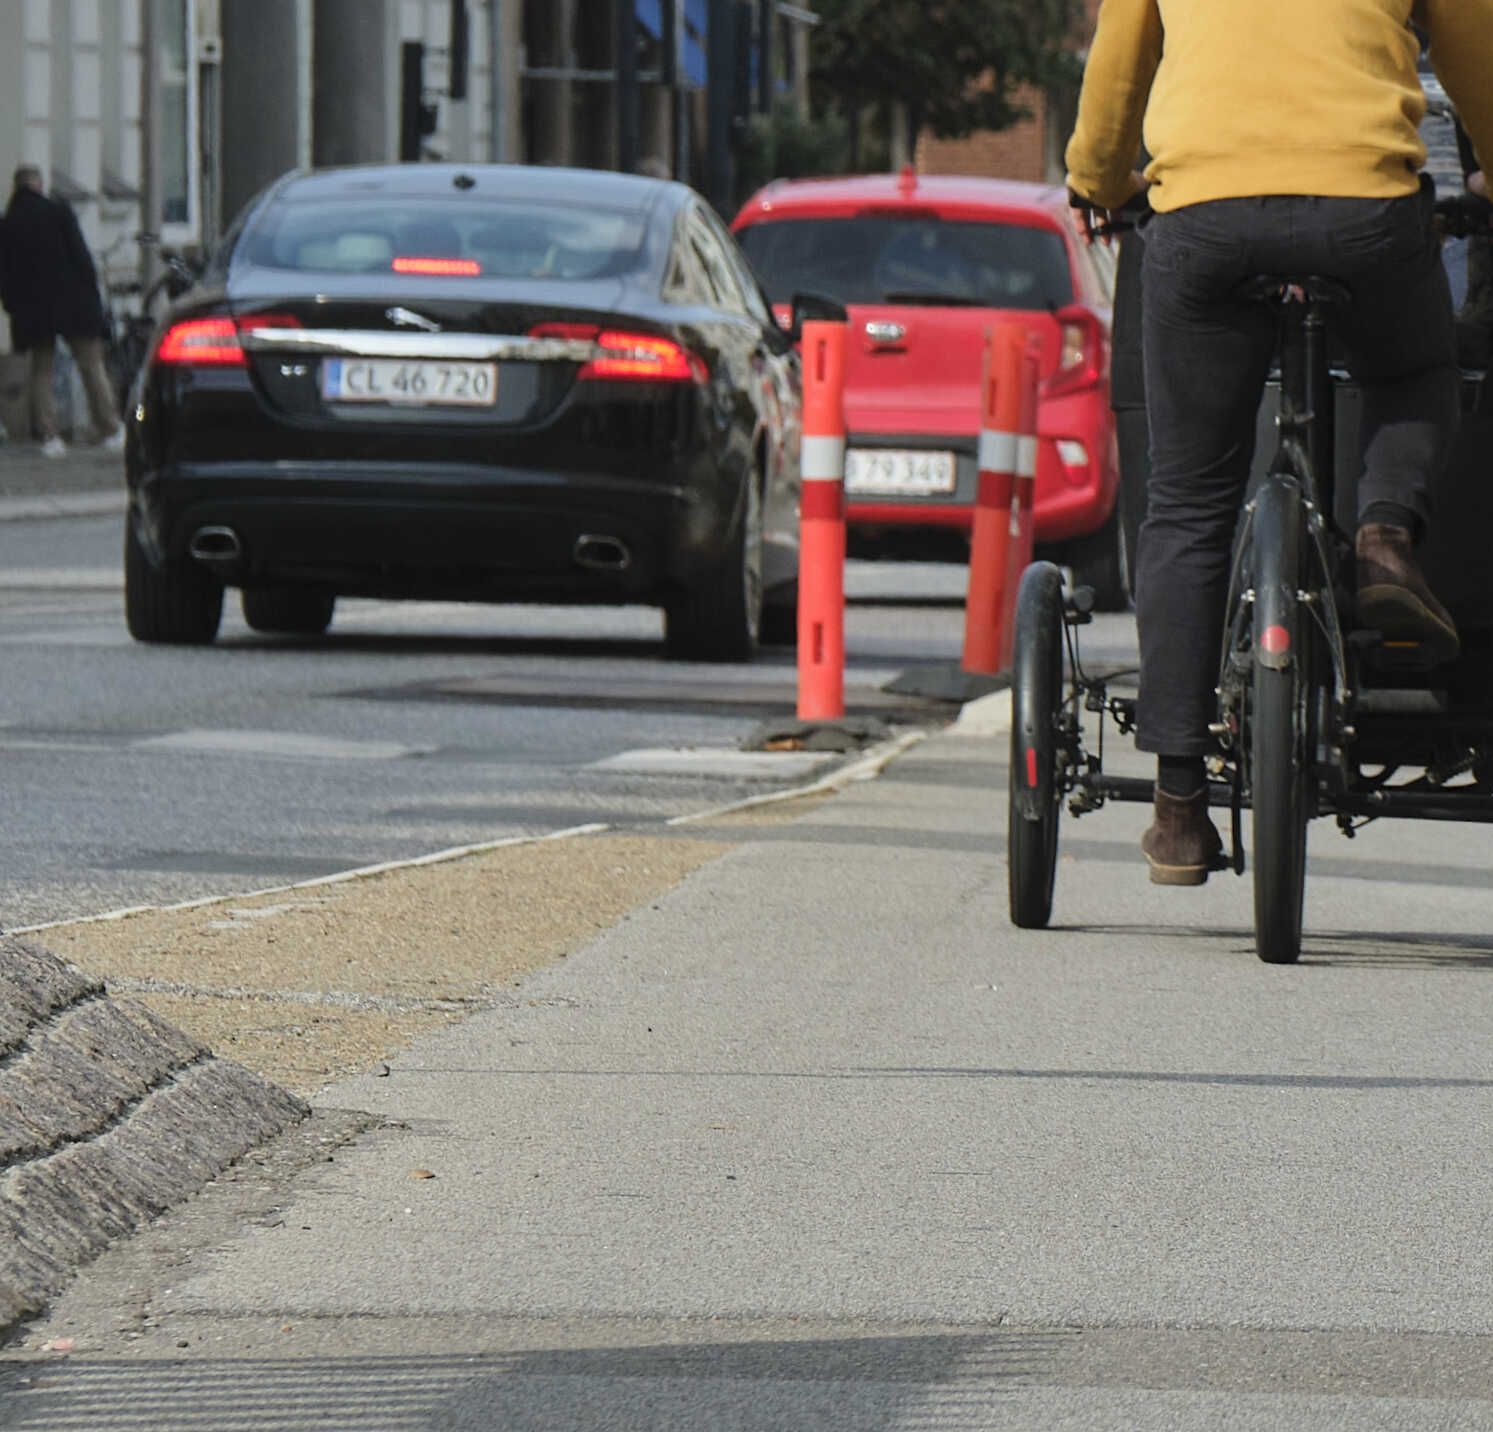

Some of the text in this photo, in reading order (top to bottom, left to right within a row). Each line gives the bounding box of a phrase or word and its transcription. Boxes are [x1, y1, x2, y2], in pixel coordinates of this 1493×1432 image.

[346, 364, 489, 398] CL 46 720
